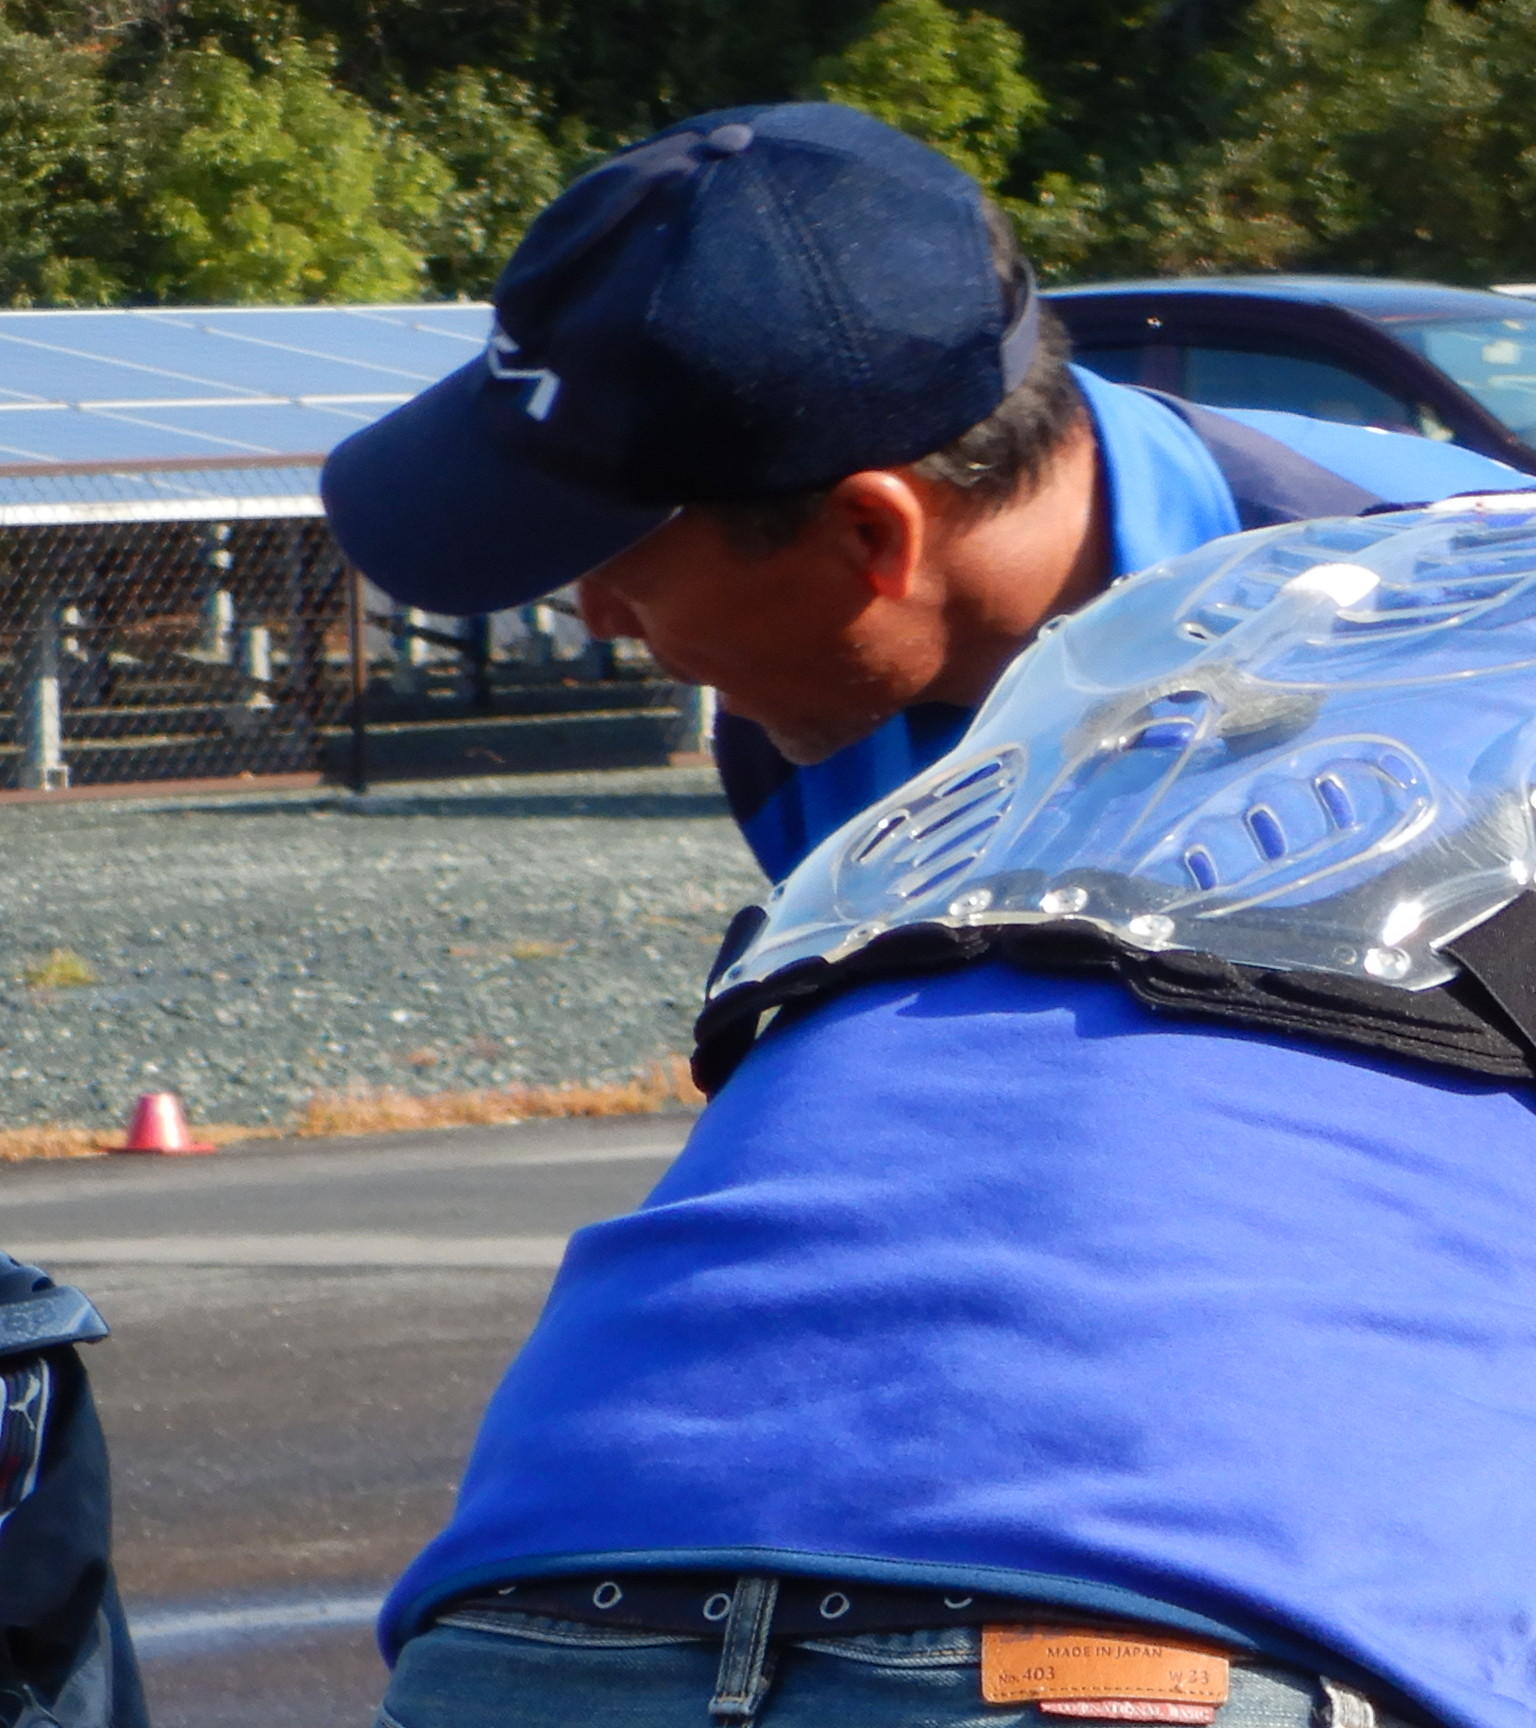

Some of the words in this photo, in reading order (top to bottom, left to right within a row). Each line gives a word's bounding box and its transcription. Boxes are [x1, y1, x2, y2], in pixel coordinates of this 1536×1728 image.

[1047, 1647, 1091, 1658] MADE
[1095, 1647, 1112, 1658] IN
[1114, 1647, 1163, 1660] JAPAN
[1022, 1666, 1056, 1682] 403
